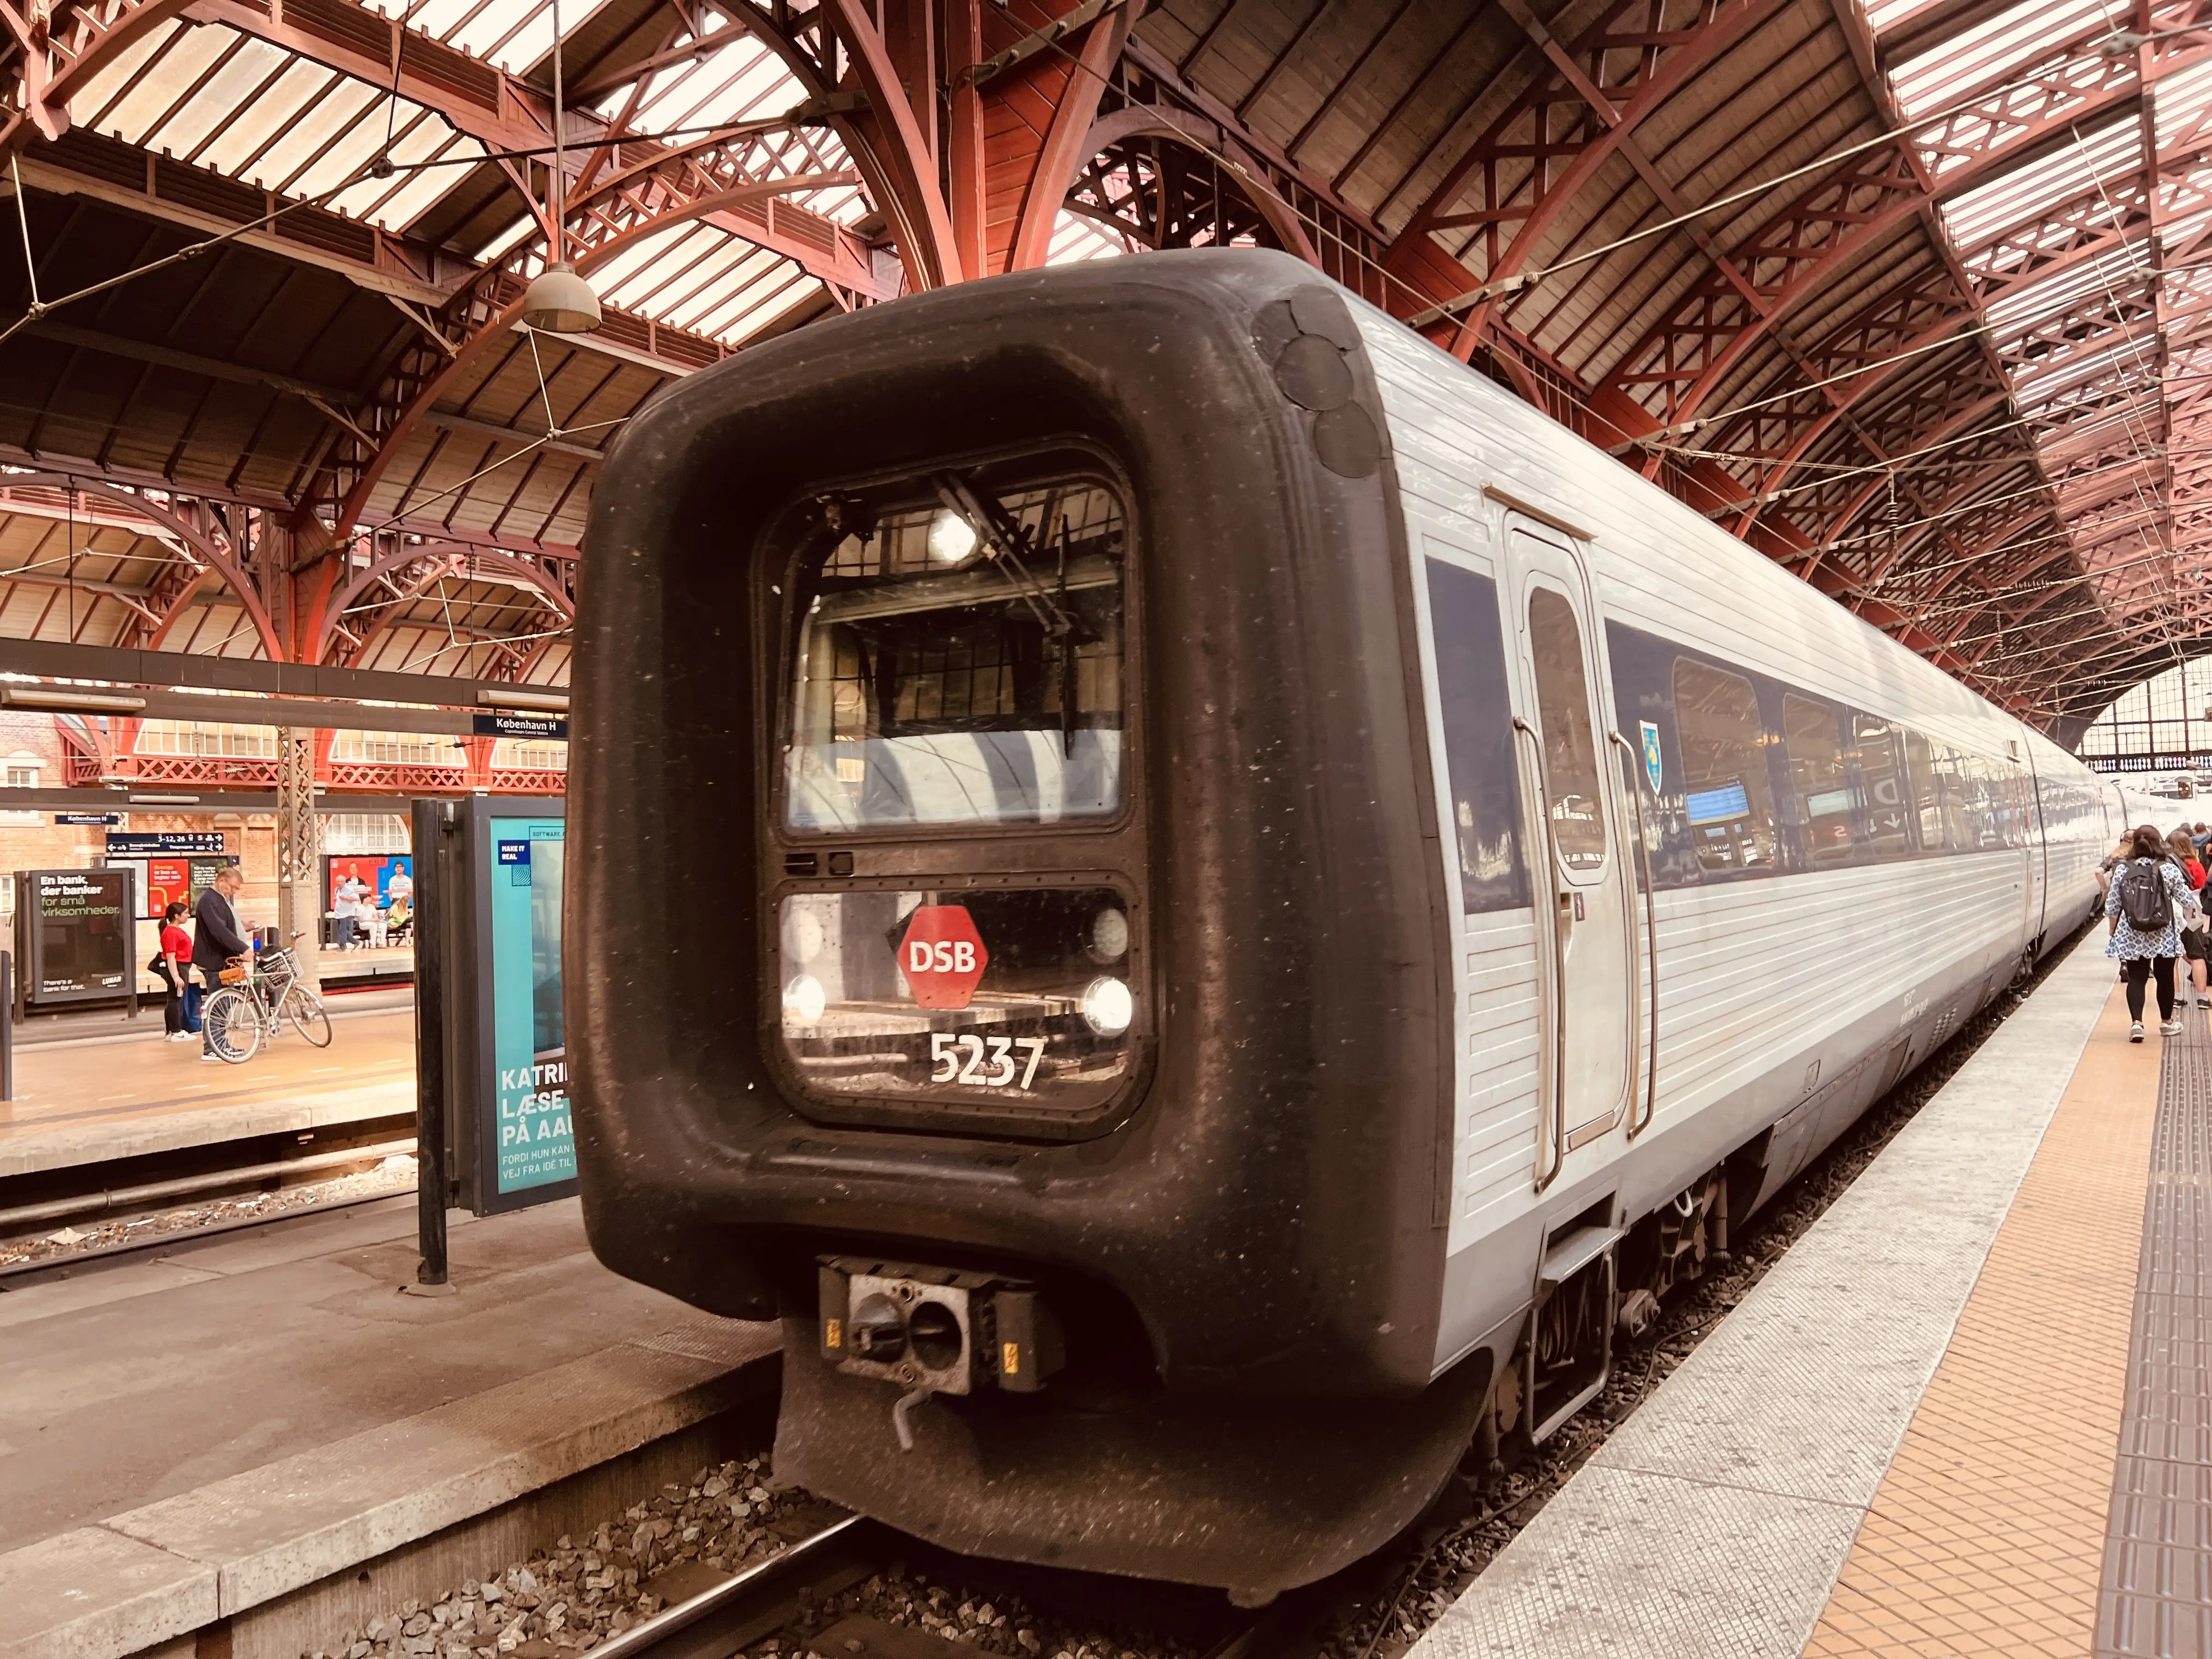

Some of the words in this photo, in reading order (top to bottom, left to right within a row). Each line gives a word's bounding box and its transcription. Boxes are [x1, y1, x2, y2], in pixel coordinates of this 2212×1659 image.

[496, 718, 546, 730] København
[549, 722, 556, 731] H
[40, 876, 55, 885] En
[57, 875, 88, 885] bank,
[41, 887, 61, 895] der
[63, 885, 103, 895] banker
[42, 896, 58, 906] for
[60, 895, 85, 905] små
[42, 906, 120, 917] virksomheder.
[909, 940, 976, 973] DSB
[102, 975, 122, 985] LUNAR
[930, 1033, 1045, 1090] 5237
[503, 1115, 531, 1147] PÅ
[503, 1152, 529, 1166] FORDI
[531, 1148, 550, 1162] HUN
[552, 1144, 570, 1156] KAN
[503, 1167, 520, 1180] VEJ
[523, 1164, 540, 1176] FRA
[543, 1159, 556, 1172] IDÉ
[560, 1159, 572, 1168] TIL
